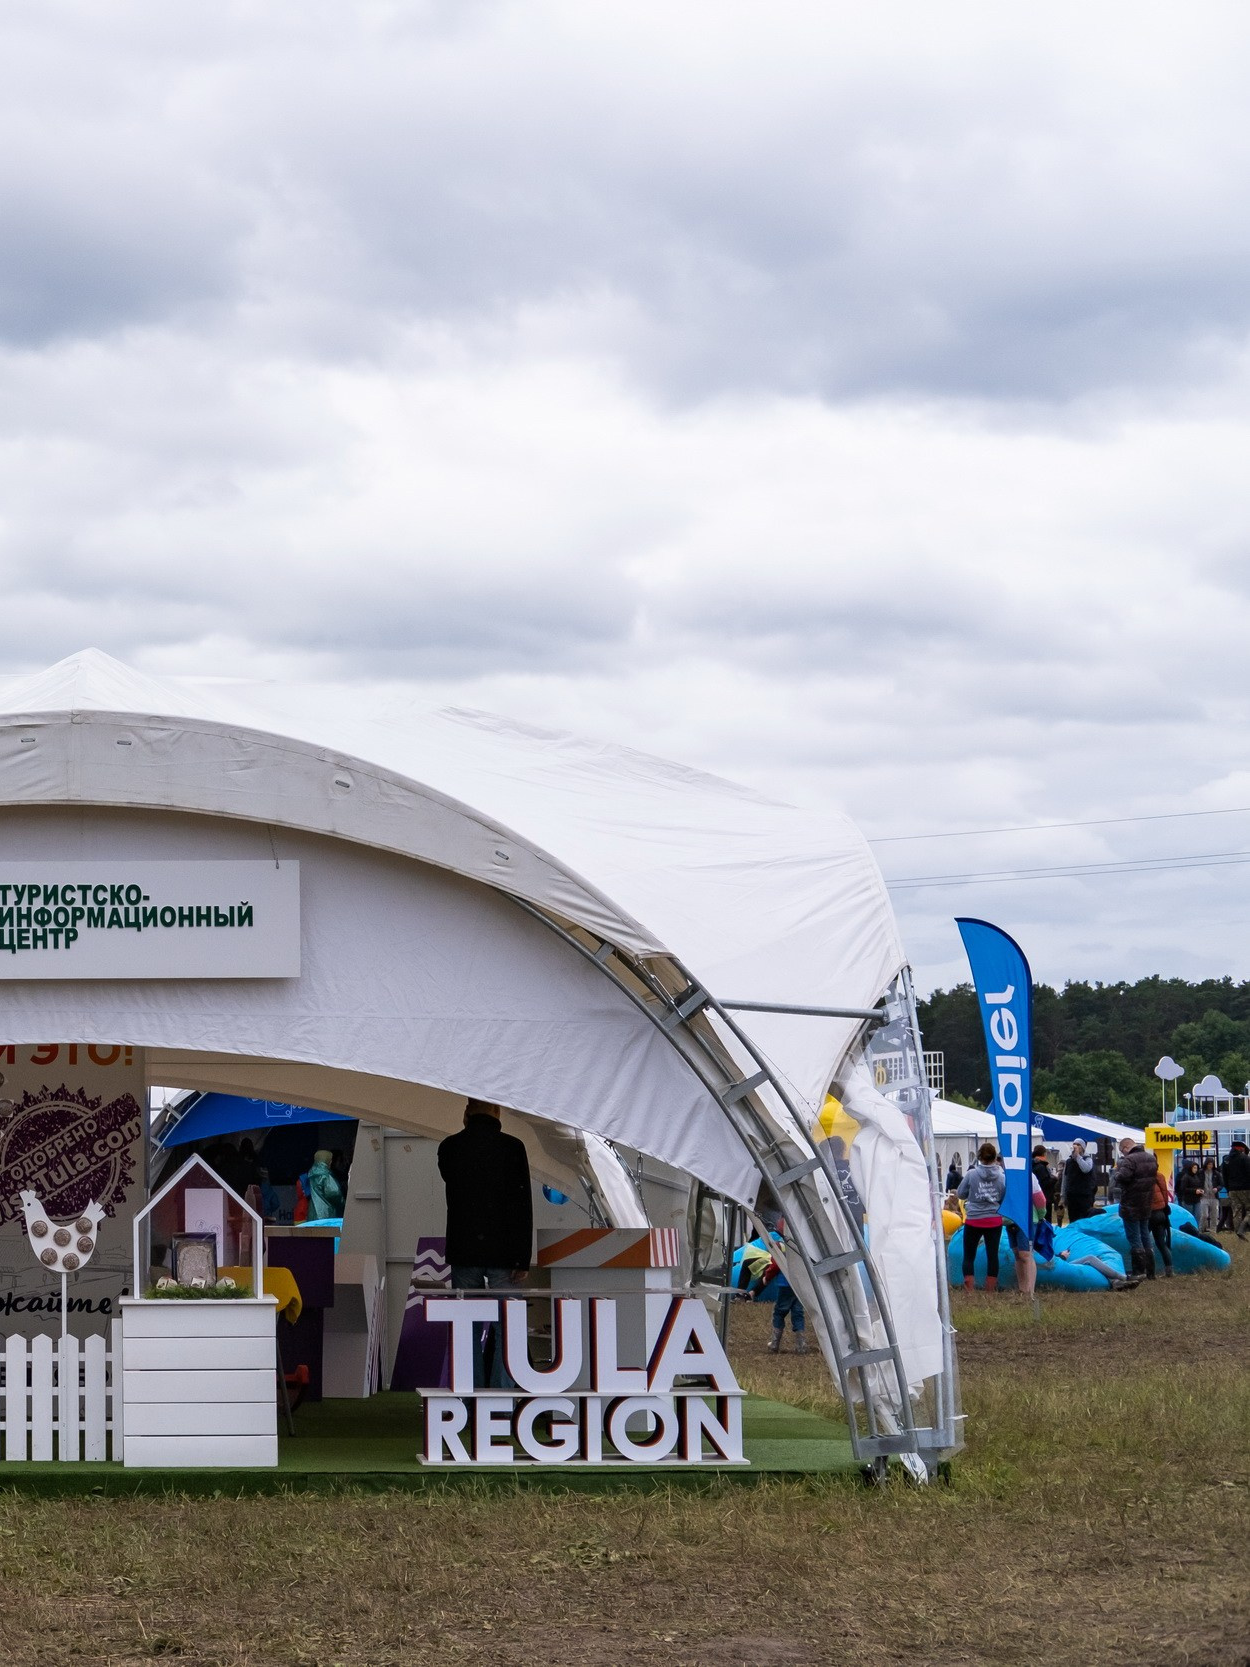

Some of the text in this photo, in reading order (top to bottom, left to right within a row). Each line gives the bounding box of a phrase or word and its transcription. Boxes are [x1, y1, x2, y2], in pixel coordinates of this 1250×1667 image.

[984, 984, 1028, 1171] Haier
[10, 1117, 98, 1180] ОДОБРЕНО
[423, 1298, 735, 1393] TULA
[423, 1396, 748, 1464] REGION
